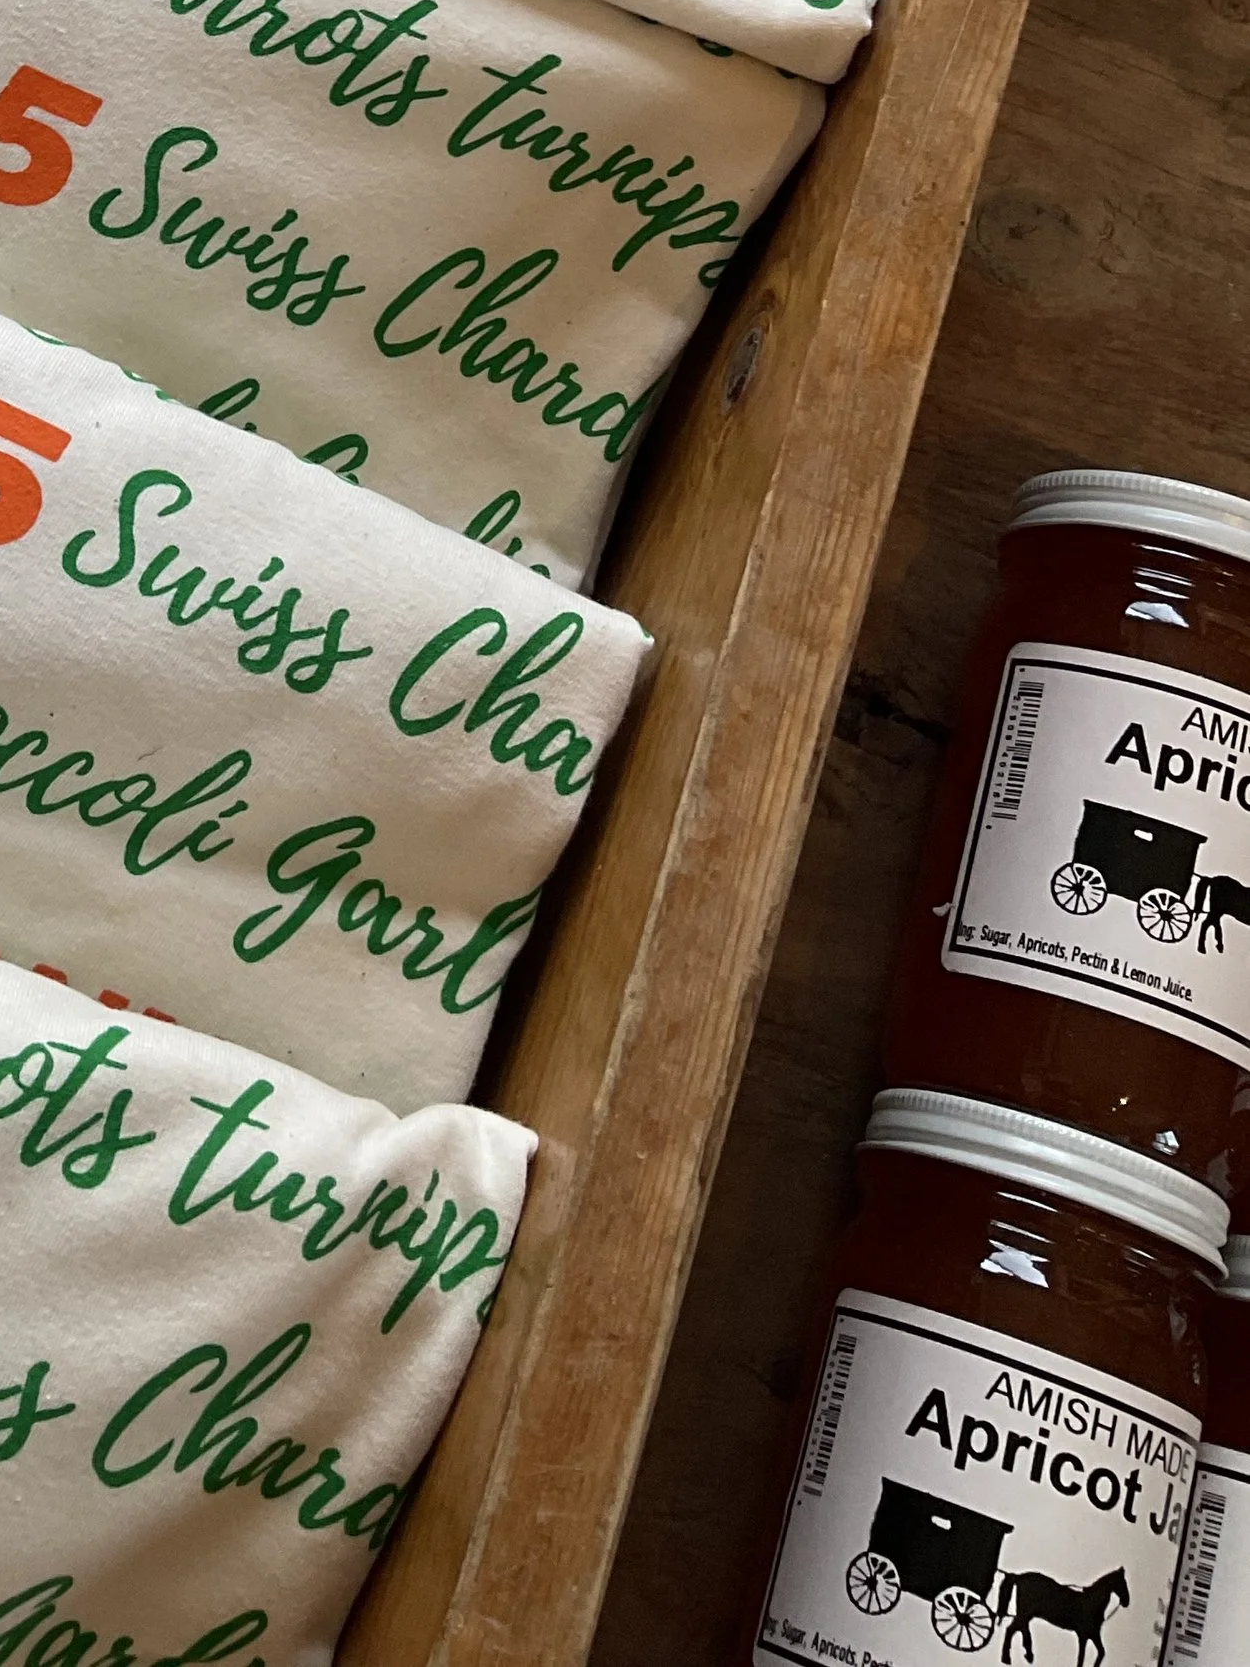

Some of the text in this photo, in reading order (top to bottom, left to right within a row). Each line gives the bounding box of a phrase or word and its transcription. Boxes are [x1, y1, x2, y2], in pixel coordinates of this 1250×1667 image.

[89, 126, 366, 326] Swiss
[61, 469, 374, 694] Swiss
[1180, 706, 1250, 755] AMI
[980, 924, 1012, 949] Sugar,
[1016, 931, 1068, 962] Apricots,
[1071, 946, 1109, 973] Pectin
[1111, 958, 1120, 975] &
[1122, 961, 1162, 990] Lemon
[167, 1079, 507, 1334] turnip
[904, 1387, 1143, 1524] Apricot
[1149, 1482, 1184, 1546] Ja
[984, 1371, 1193, 1485] AMISH MADE
